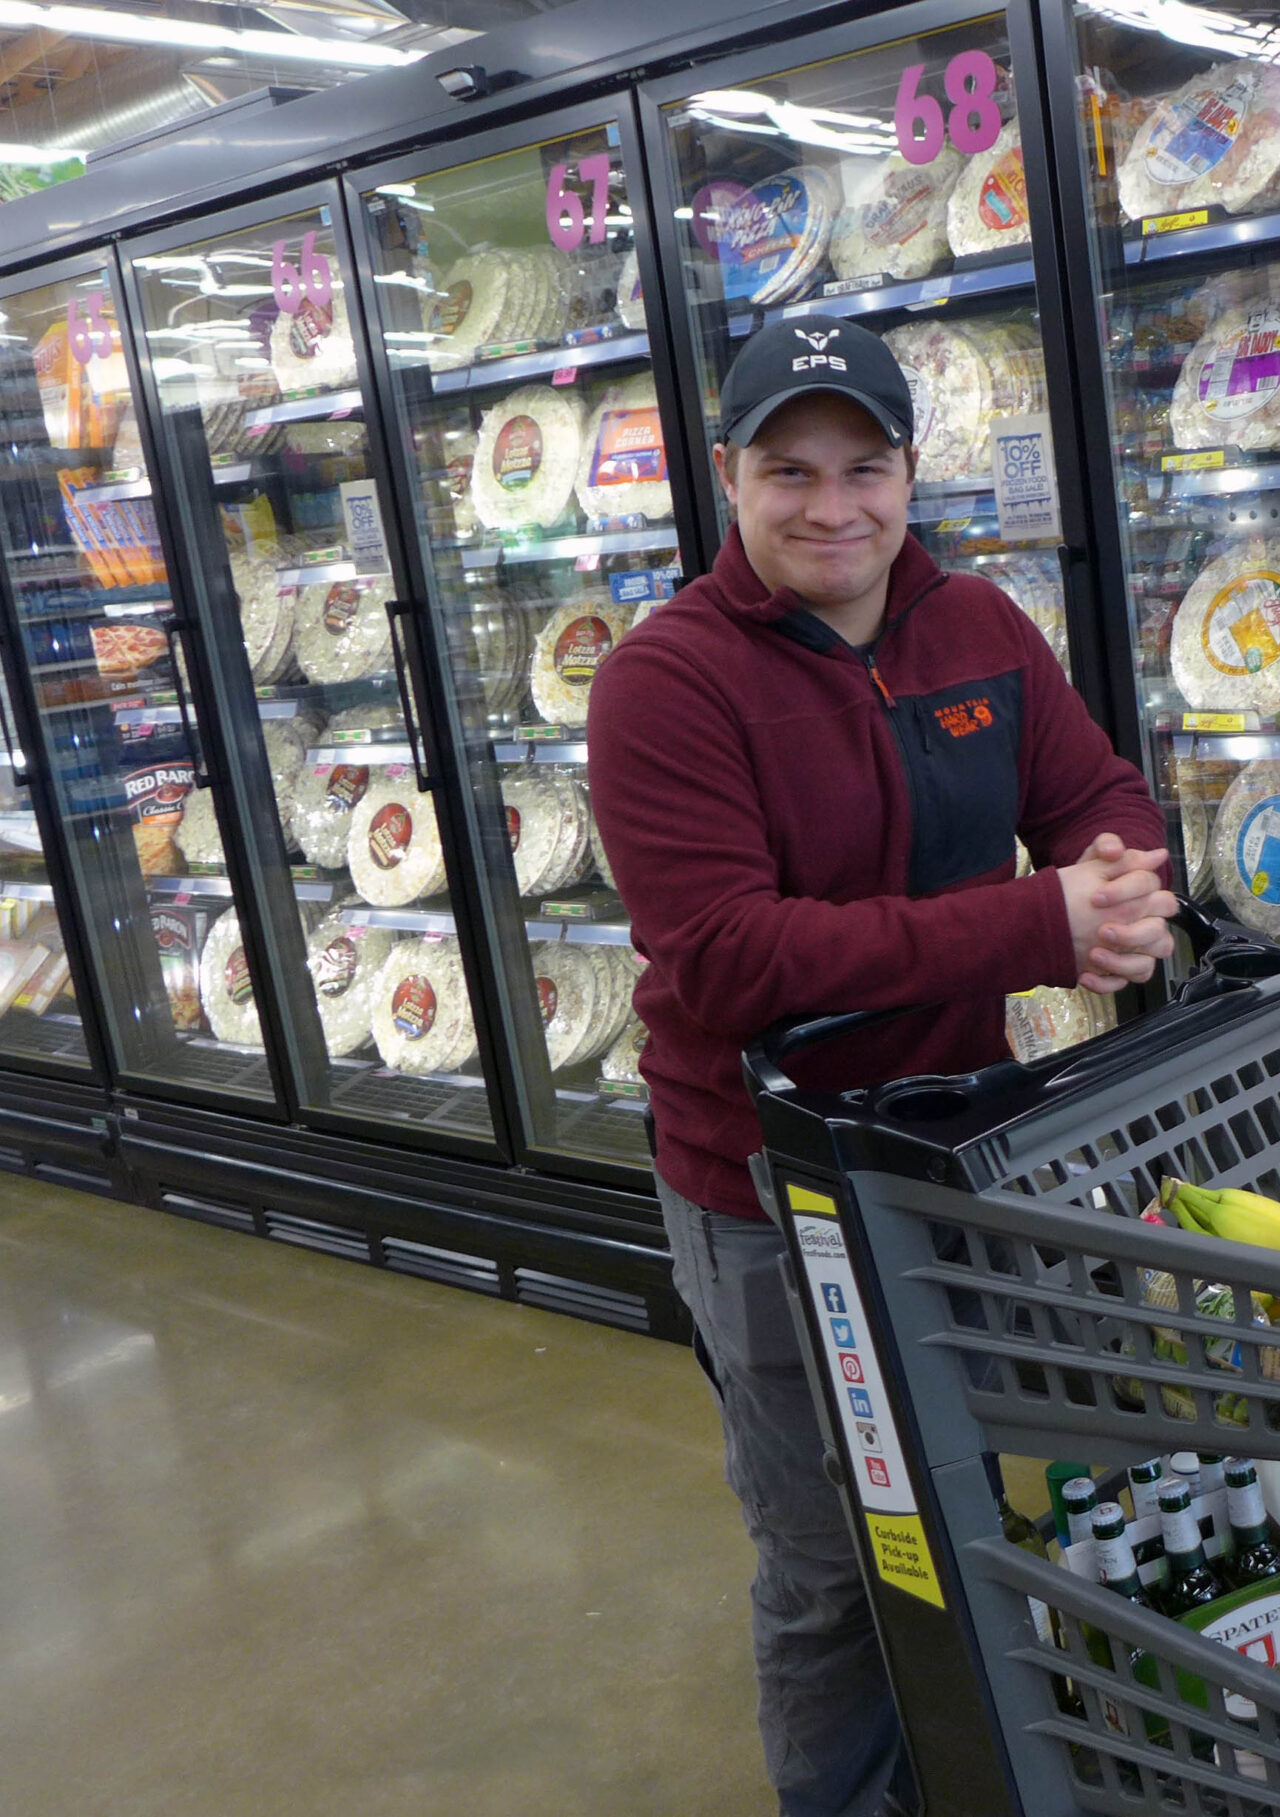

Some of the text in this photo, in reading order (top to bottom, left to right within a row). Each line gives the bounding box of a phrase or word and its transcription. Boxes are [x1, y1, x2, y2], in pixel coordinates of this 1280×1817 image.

[893, 49, 1001, 165] 68
[546, 153, 610, 250] 67
[271, 230, 332, 313] 66
[792, 354, 848, 371] EPS
[1002, 442, 1041, 463] 10%
[1004, 459, 1042, 479] OFF
[125, 775, 156, 799] RED
[142, 804, 175, 817] Classic
[874, 1525, 918, 1546] Curbside
[881, 1543, 919, 1564] Pick-up
[881, 1558, 930, 1580] Available
